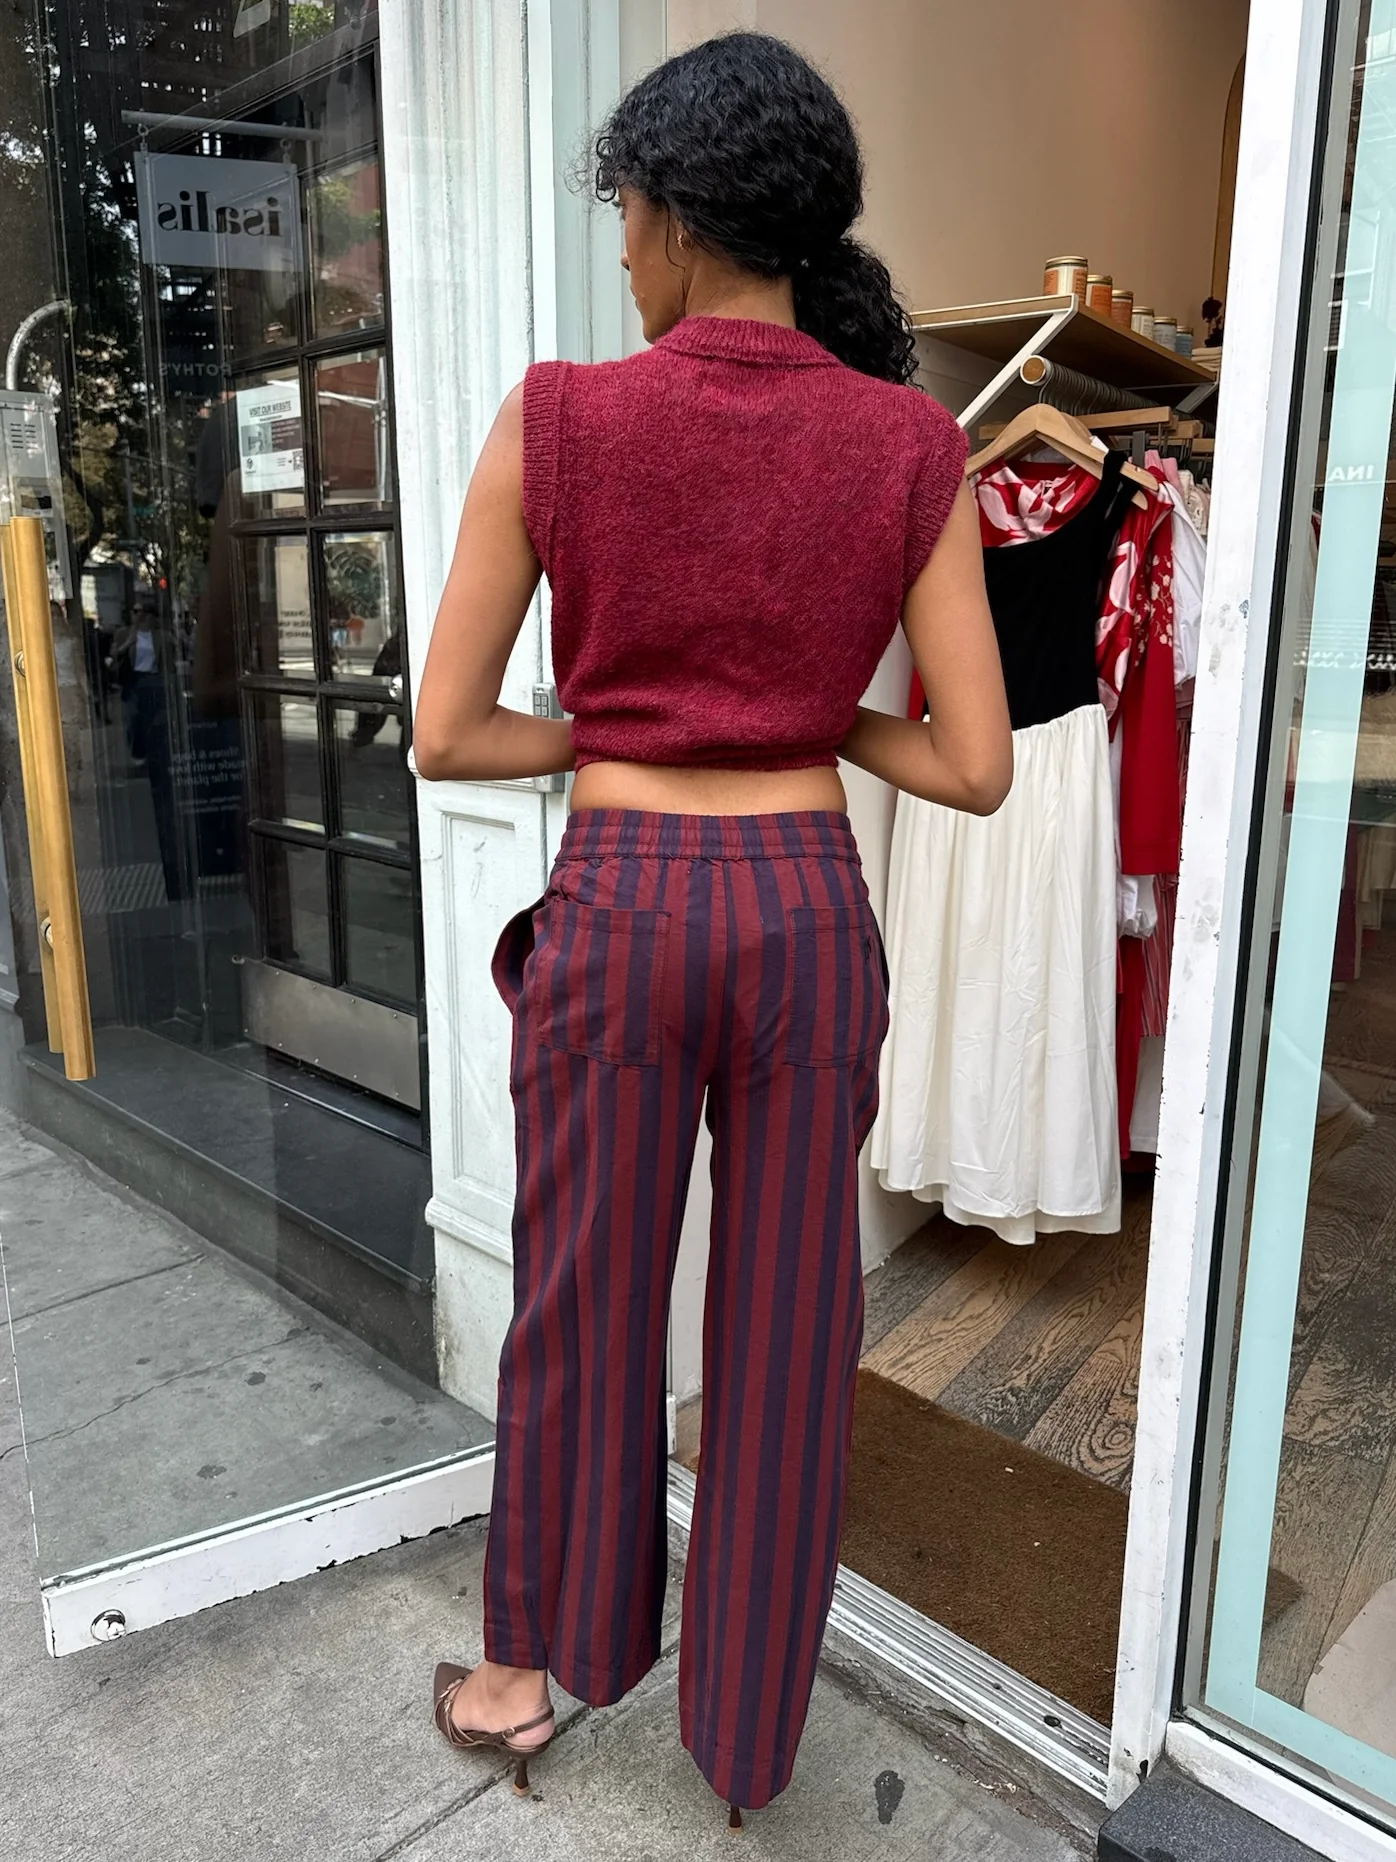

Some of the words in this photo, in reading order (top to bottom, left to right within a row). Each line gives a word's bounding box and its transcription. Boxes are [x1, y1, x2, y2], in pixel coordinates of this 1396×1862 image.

[249, 406, 260, 416] VISIT
[261, 404, 271, 414] OUR
[272, 400, 292, 412] WEBSITE
